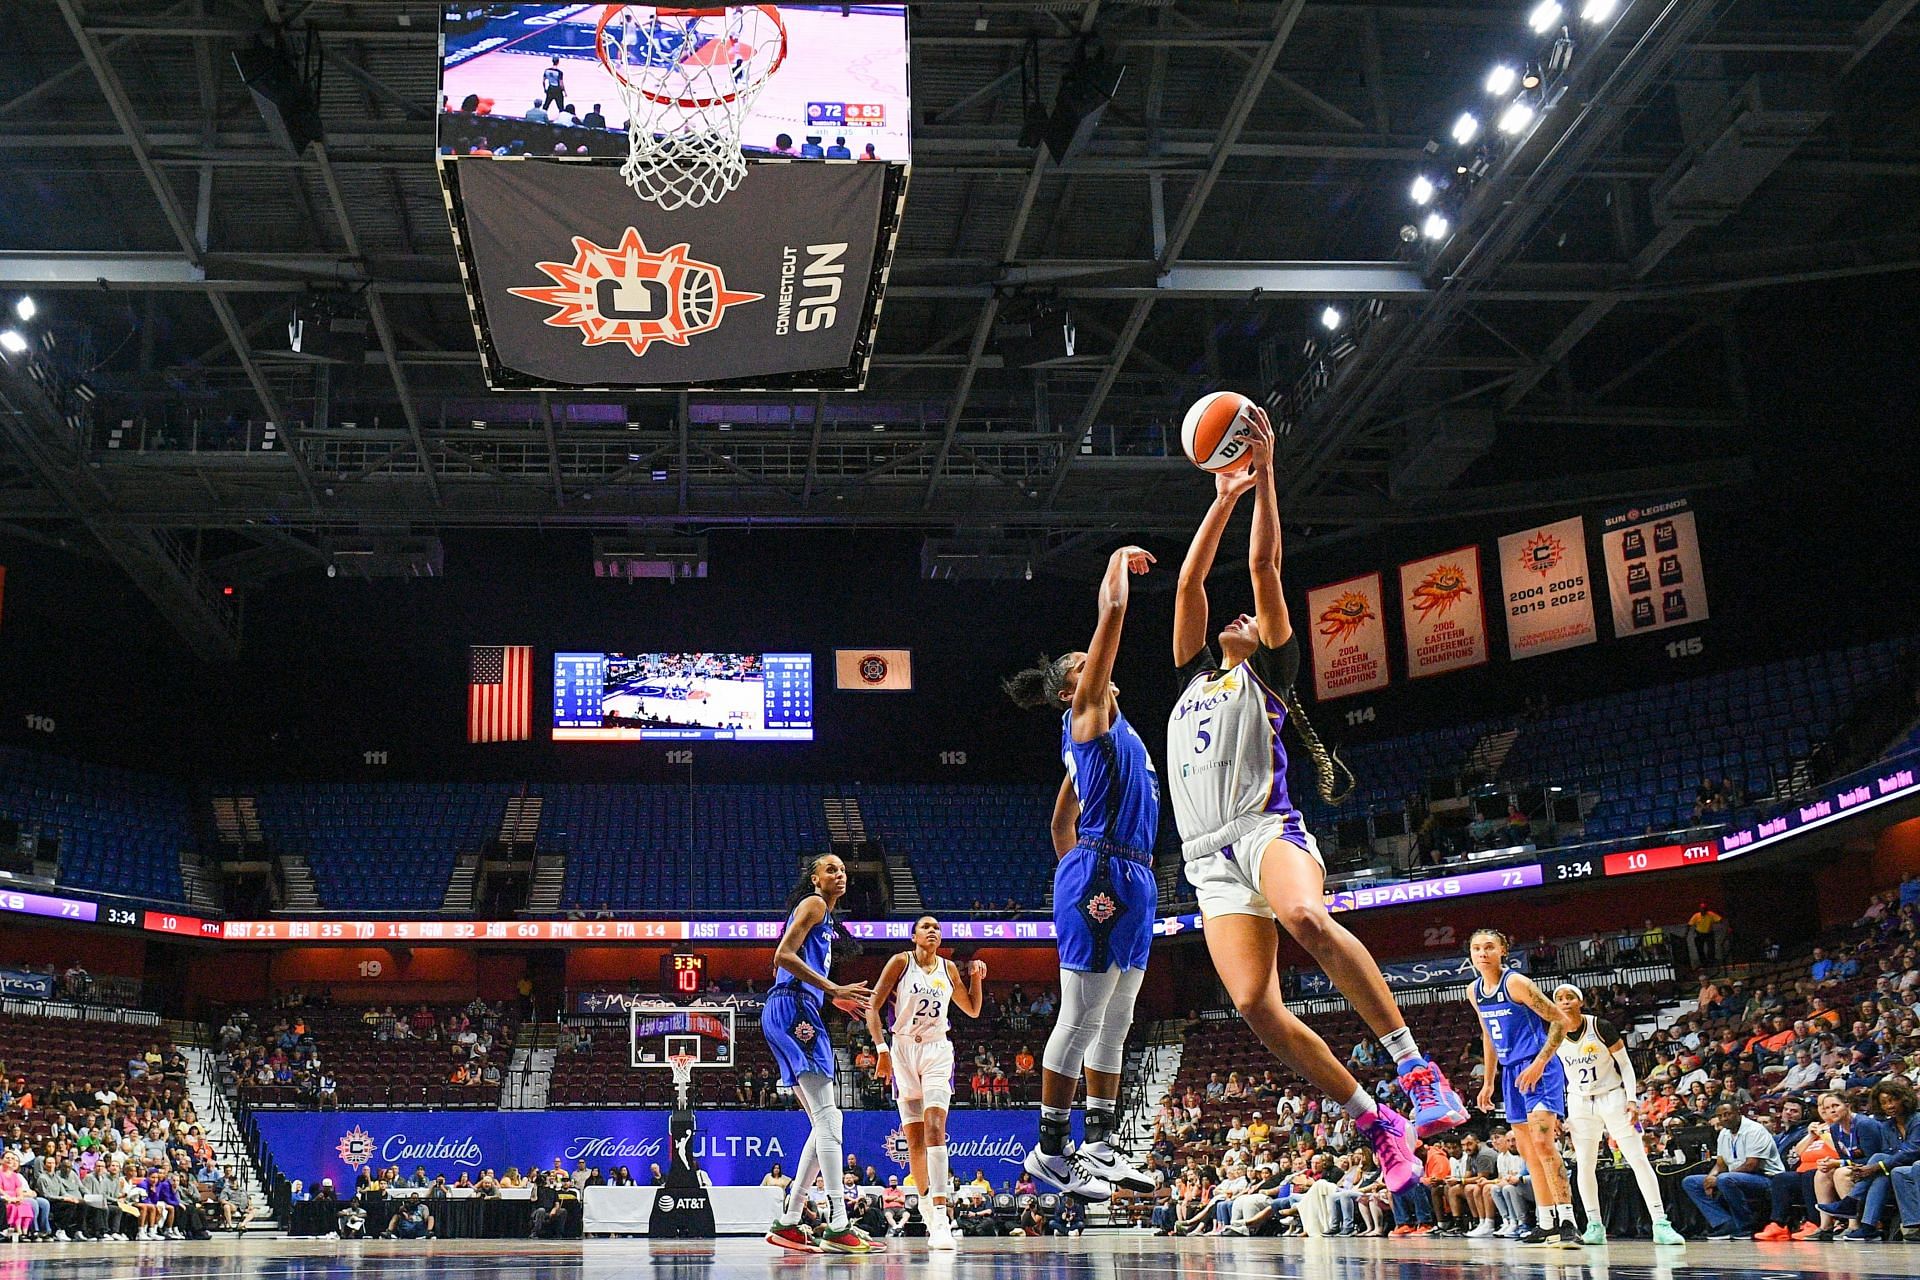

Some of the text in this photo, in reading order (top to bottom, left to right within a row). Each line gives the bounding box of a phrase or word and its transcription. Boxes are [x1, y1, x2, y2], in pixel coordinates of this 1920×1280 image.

[825, 105, 842, 116] 72
[776, 246, 798, 336] CONNECTICUT
[796, 243, 848, 332] SUN
[1605, 499, 1688, 526] SUN LEGENDS
[1626, 535, 1639, 546] 12
[1656, 526, 1672, 538] 42
[1629, 567, 1646, 579] 23
[1663, 560, 1676, 572] 13
[1510, 576, 1584, 602] 2004 2005
[1511, 590, 1586, 616] 2019 2022
[1636, 602, 1649, 614] 15
[1425, 628, 1464, 644] EASTERN
[1338, 646, 1359, 656] 2004
[1416, 636, 1475, 656] CONFERENCE
[1665, 637, 1704, 658] 115
[1332, 652, 1368, 668] EASTERN
[1420, 647, 1474, 666] CHAMPIONS
[1324, 660, 1378, 680] CONFERENCE
[1327, 670, 1377, 689] CHAMPIONS
[25, 713, 55, 733] 110
[1345, 706, 1376, 726] 114
[1194, 716, 1212, 754] 5
[363, 750, 388, 764] 111
[666, 751, 692, 764] 112
[939, 752, 967, 764] 113
[1628, 854, 1647, 869] 10
[1684, 846, 1709, 860] 4TH
[1557, 861, 1592, 879] 3:34
[1358, 872, 1523, 906] SPARKS 72
[61, 903, 80, 917] 72
[108, 909, 136, 924] 3:34
[162, 917, 177, 930] 10
[202, 923, 219, 933] 4TH
[225, 924, 251, 937] ASST
[256, 924, 276, 937] 21
[289, 924, 310, 937] REB
[322, 924, 342, 937] 35
[388, 924, 408, 937] 15
[420, 924, 442, 937] FGM
[455, 924, 475, 937] 32
[486, 924, 506, 937] FGA
[518, 924, 539, 937] 60
[552, 924, 573, 937] FTM
[586, 924, 606, 937] 12
[617, 924, 635, 937] FTA
[646, 924, 666, 937] 14
[694, 924, 720, 937] ASST
[728, 924, 748, 937] 16
[757, 924, 777, 937] REB
[854, 924, 874, 937] 12
[886, 924, 908, 937] FGM
[952, 924, 972, 937] FGA
[983, 924, 1003, 937] 54
[1016, 924, 1037, 937] FTM
[1424, 926, 1456, 947] 22
[358, 960, 382, 977] 19
[675, 957, 701, 970] 3:34
[679, 970, 696, 991] 10
[1412, 964, 1452, 982] Sun
[604, 993, 676, 1012] Mohegan
[721, 994, 766, 1012] Aren
[915, 999, 941, 1018] 23
[1489, 1020, 1502, 1040] 2
[1578, 1066, 1598, 1084] 21
[382, 1134, 482, 1167] Courtside
[564, 1135, 664, 1160] Michelob
[676, 1198, 706, 1210] AT&T
